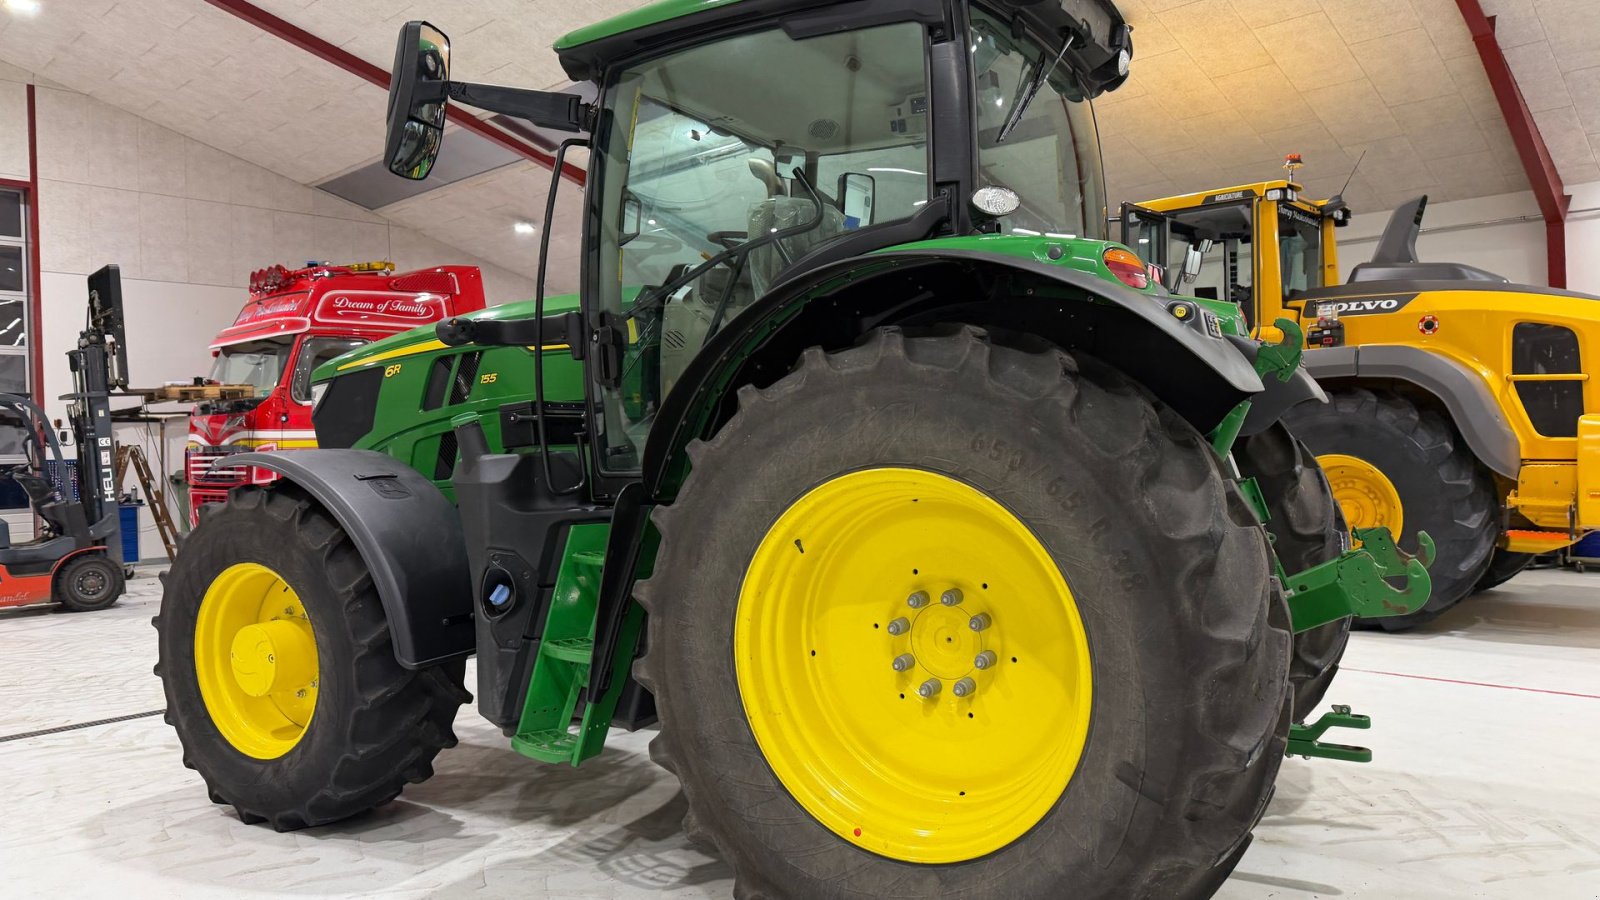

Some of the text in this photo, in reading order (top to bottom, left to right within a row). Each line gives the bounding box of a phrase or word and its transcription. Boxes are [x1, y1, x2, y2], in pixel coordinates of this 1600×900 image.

[333, 296, 427, 316] Dream of Family
[1324, 299, 1398, 312] OLVO
[385, 364, 402, 378] 6R
[480, 373, 498, 385] 155
[102, 468, 115, 502] HELI
